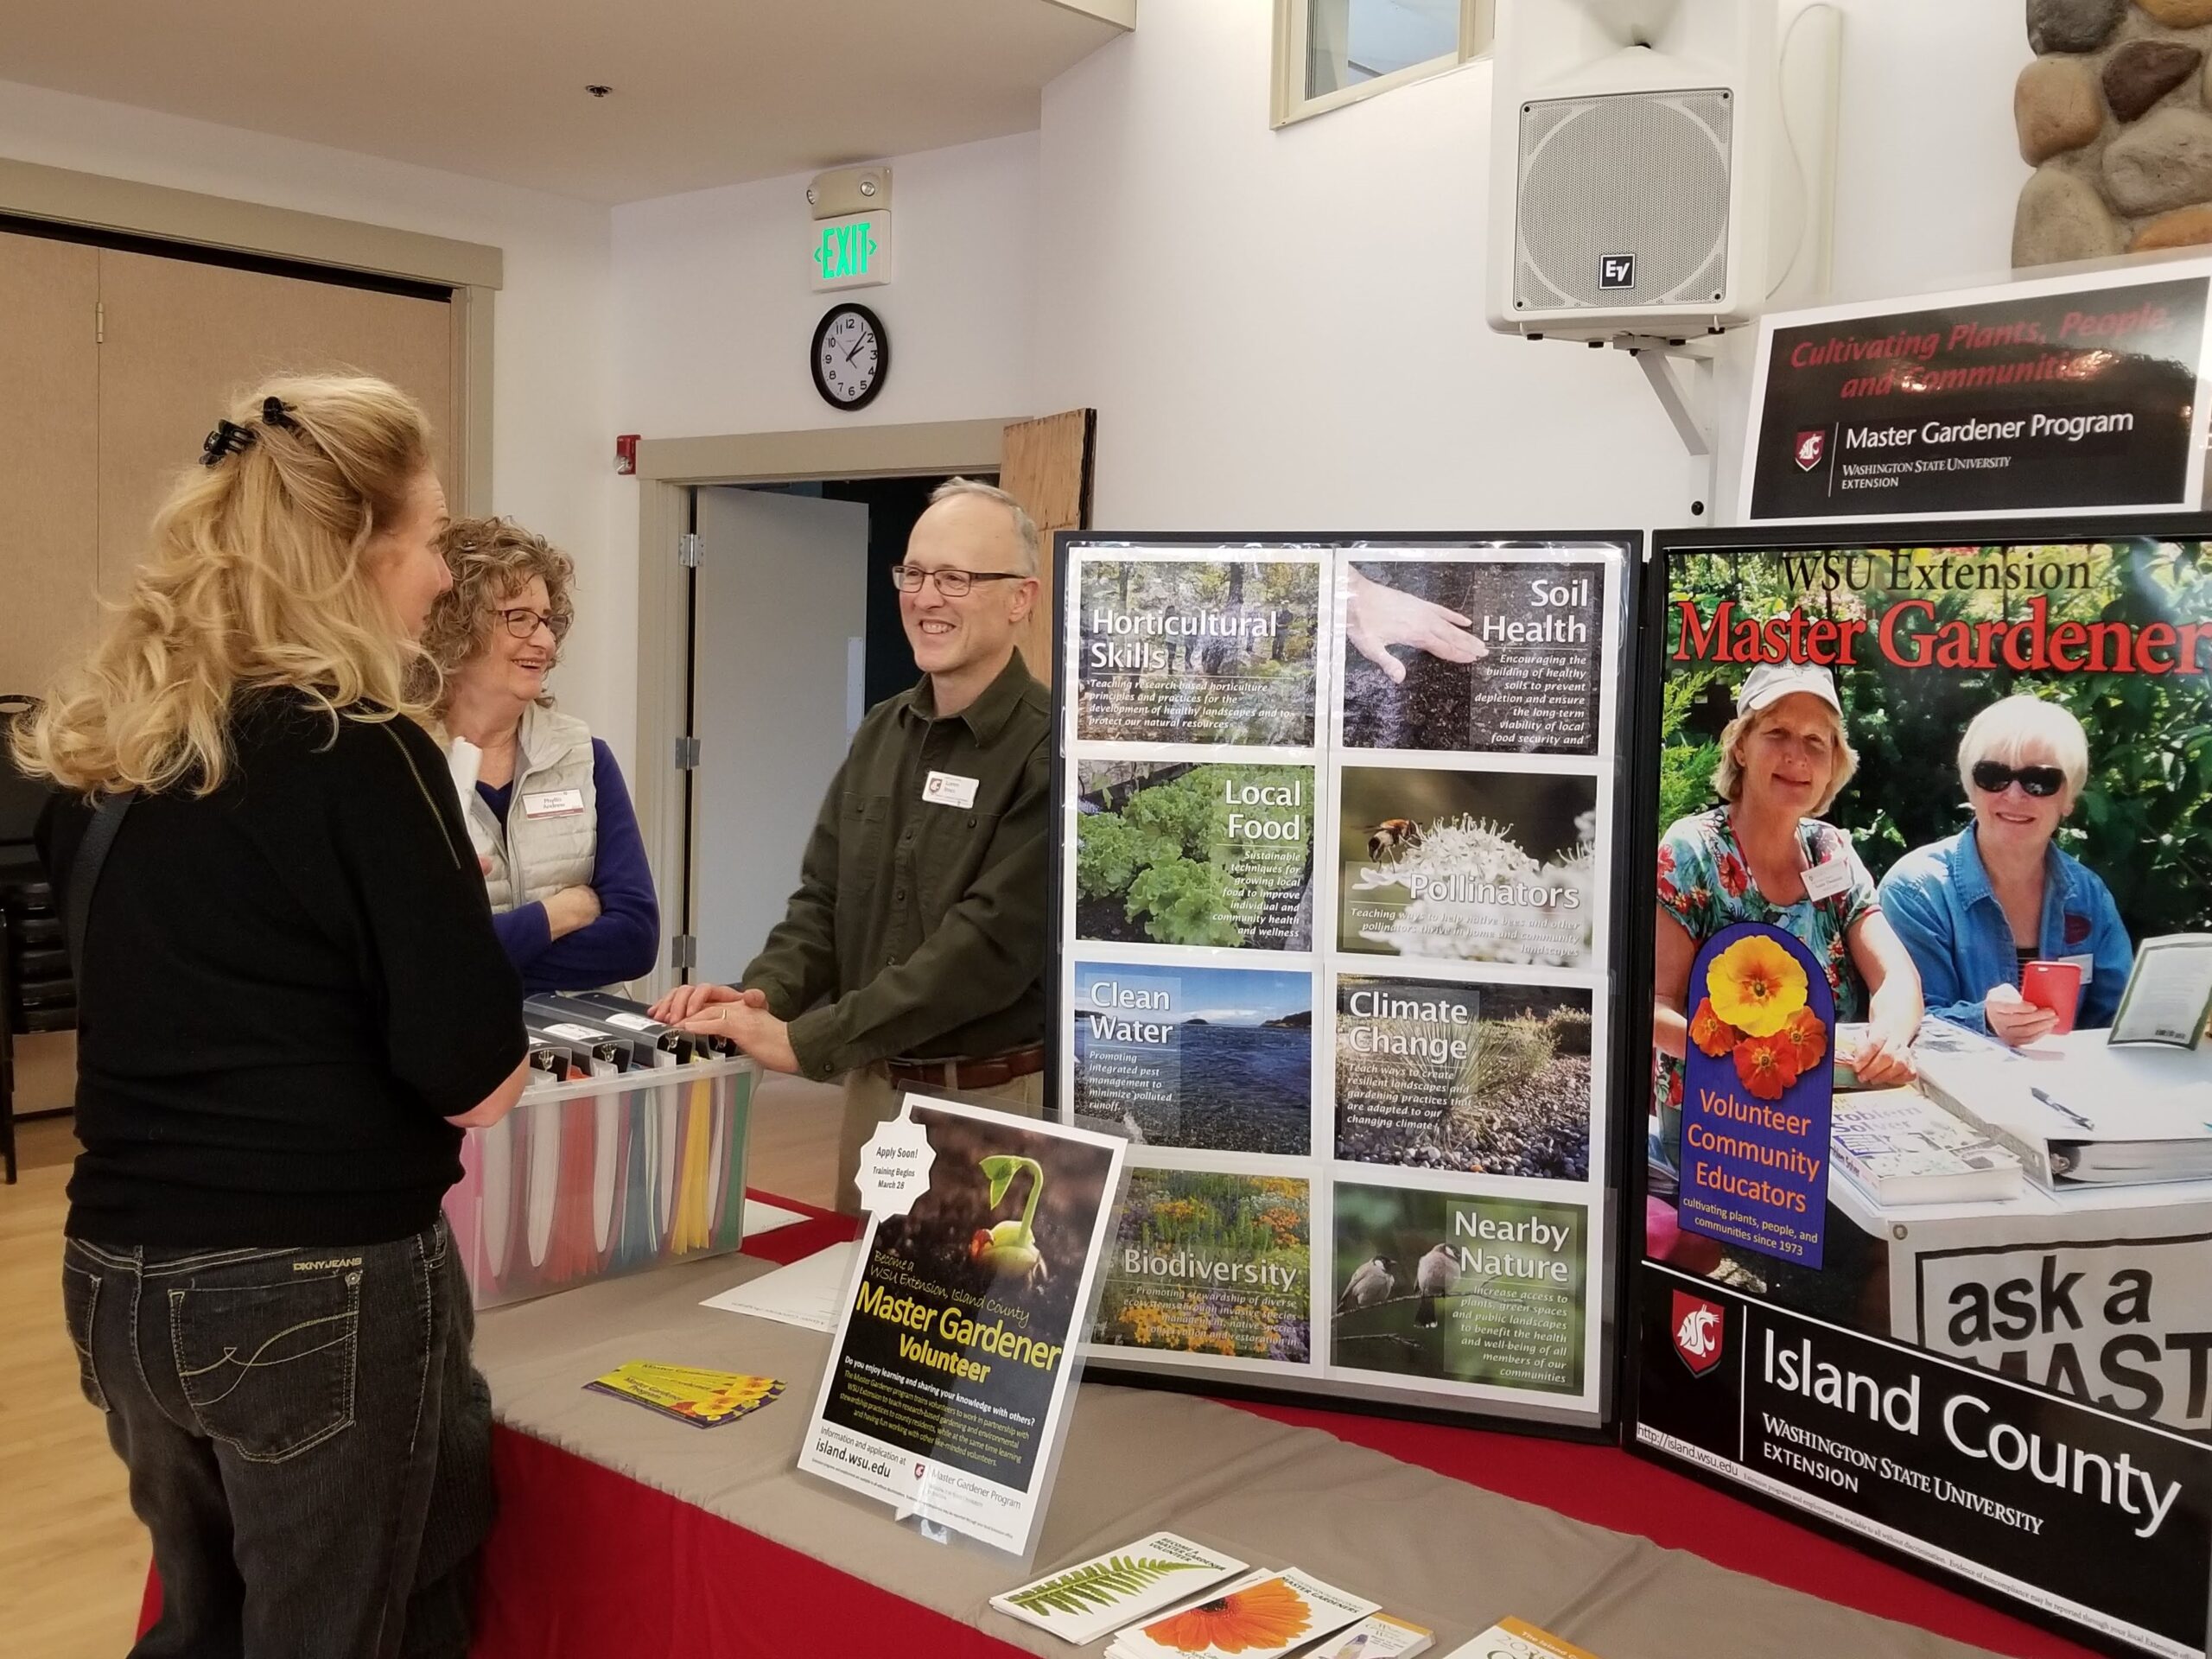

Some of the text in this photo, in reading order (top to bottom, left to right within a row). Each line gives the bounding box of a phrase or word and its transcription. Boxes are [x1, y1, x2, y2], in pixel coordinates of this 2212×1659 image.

[823, 222, 870, 279] EXIT
[1606, 260, 1630, 282] EV
[836, 324, 842, 334] 11
[846, 319, 855, 329] 12
[867, 333, 874, 343] 2
[1790, 302, 2173, 369] Cultivating Plants, People,
[828, 337, 836, 348] 10
[870, 350, 878, 360] 3
[825, 354, 832, 364] 9
[868, 366, 875, 376] 4
[829, 371, 836, 380] 8
[837, 383, 844, 392] 7
[860, 380, 868, 390] 5
[1841, 352, 2108, 399] and Communiti
[849, 386, 855, 396] 6
[1846, 412, 2134, 450] Master Gardener Program
[1842, 456, 2012, 477] WASHINGTON STATE UNIVERSITY
[1841, 477, 1899, 490] EXTENSION
[1783, 553, 2092, 591] WSU Extension
[1530, 579, 1589, 607] Soil
[1092, 608, 1278, 638] Horticultural
[1483, 614, 1587, 643] Health
[1673, 595, 2212, 677] Master Gardener
[1090, 641, 1167, 670] Skills
[1500, 654, 1586, 665] Encouraging the
[1487, 667, 1586, 680] building of healthy
[1504, 681, 1586, 693] soils to prevent
[1474, 693, 1586, 705] depletion and ensure
[1499, 721, 1585, 732] viability of local
[1513, 708, 1585, 719] the long-term
[1491, 733, 1585, 746] food security and
[1225, 779, 1300, 806] Local
[1228, 813, 1300, 841] Food
[1231, 863, 1300, 875] techniques for
[1244, 850, 1300, 861] Sustainable
[1223, 888, 1300, 900] food to improve
[1235, 876, 1300, 887] growing local
[1410, 874, 1580, 909] Pollinators
[1237, 926, 1300, 938] and wellness
[1090, 982, 1170, 1010] Clean
[1350, 991, 1468, 1025] Climate
[1090, 1015, 1173, 1044] Water
[1090, 1051, 1137, 1063] Promoting
[1349, 1026, 1467, 1065] Change
[1089, 1076, 1149, 1088] management
[1090, 1063, 1138, 1075] integrated
[1089, 1089, 1173, 1102] minimize polluted
[1089, 1102, 1121, 1112] runoff.
[1700, 1088, 1812, 1136] Volunteer
[876, 1147, 918, 1159] Apply Soon!
[1688, 1123, 1821, 1183] Community
[874, 1166, 915, 1178] Training Begins
[878, 1179, 896, 1189] March
[1696, 1161, 1807, 1213] Educators
[1455, 1211, 1569, 1252] Nearby
[1683, 1198, 1818, 1243] cultivating plants, people, and
[1694, 1216, 1803, 1255] communities since 1973
[874, 1250, 914, 1272] Become a
[1125, 1249, 1296, 1292] Biodiversity
[1461, 1246, 1568, 1282] Nature
[870, 1264, 1030, 1329] WSU Extension, Island County
[1948, 1255, 2153, 1347] ask a
[855, 1280, 938, 1332] Master
[939, 1306, 1063, 1371] Gardener
[899, 1332, 992, 1383] Volunteer
[845, 1356, 1035, 1427] Do you enjoy learning and sharing your knowledge with others?
[821, 1426, 906, 1466] Information and application at
[1764, 1328, 2182, 1538] Island County
[816, 1438, 891, 1478] island.wsu.edu
[1637, 1424, 1738, 1476] http://island.wsu.edu
[1762, 1412, 2044, 1535] WASHINGTON STATE UNIVERSITY
[1764, 1441, 1859, 1492] EXTENSION
[931, 1467, 956, 1485] Master
[957, 1478, 990, 1497] Gardener
[991, 1490, 1021, 1510] Program
[1149, 1542, 1192, 1563] VOLUNTEER
[1156, 1540, 1227, 1573] MASTER GARDENER
[1281, 1576, 1312, 1594] MASTER
[1311, 1592, 1360, 1614] GARDENERS
